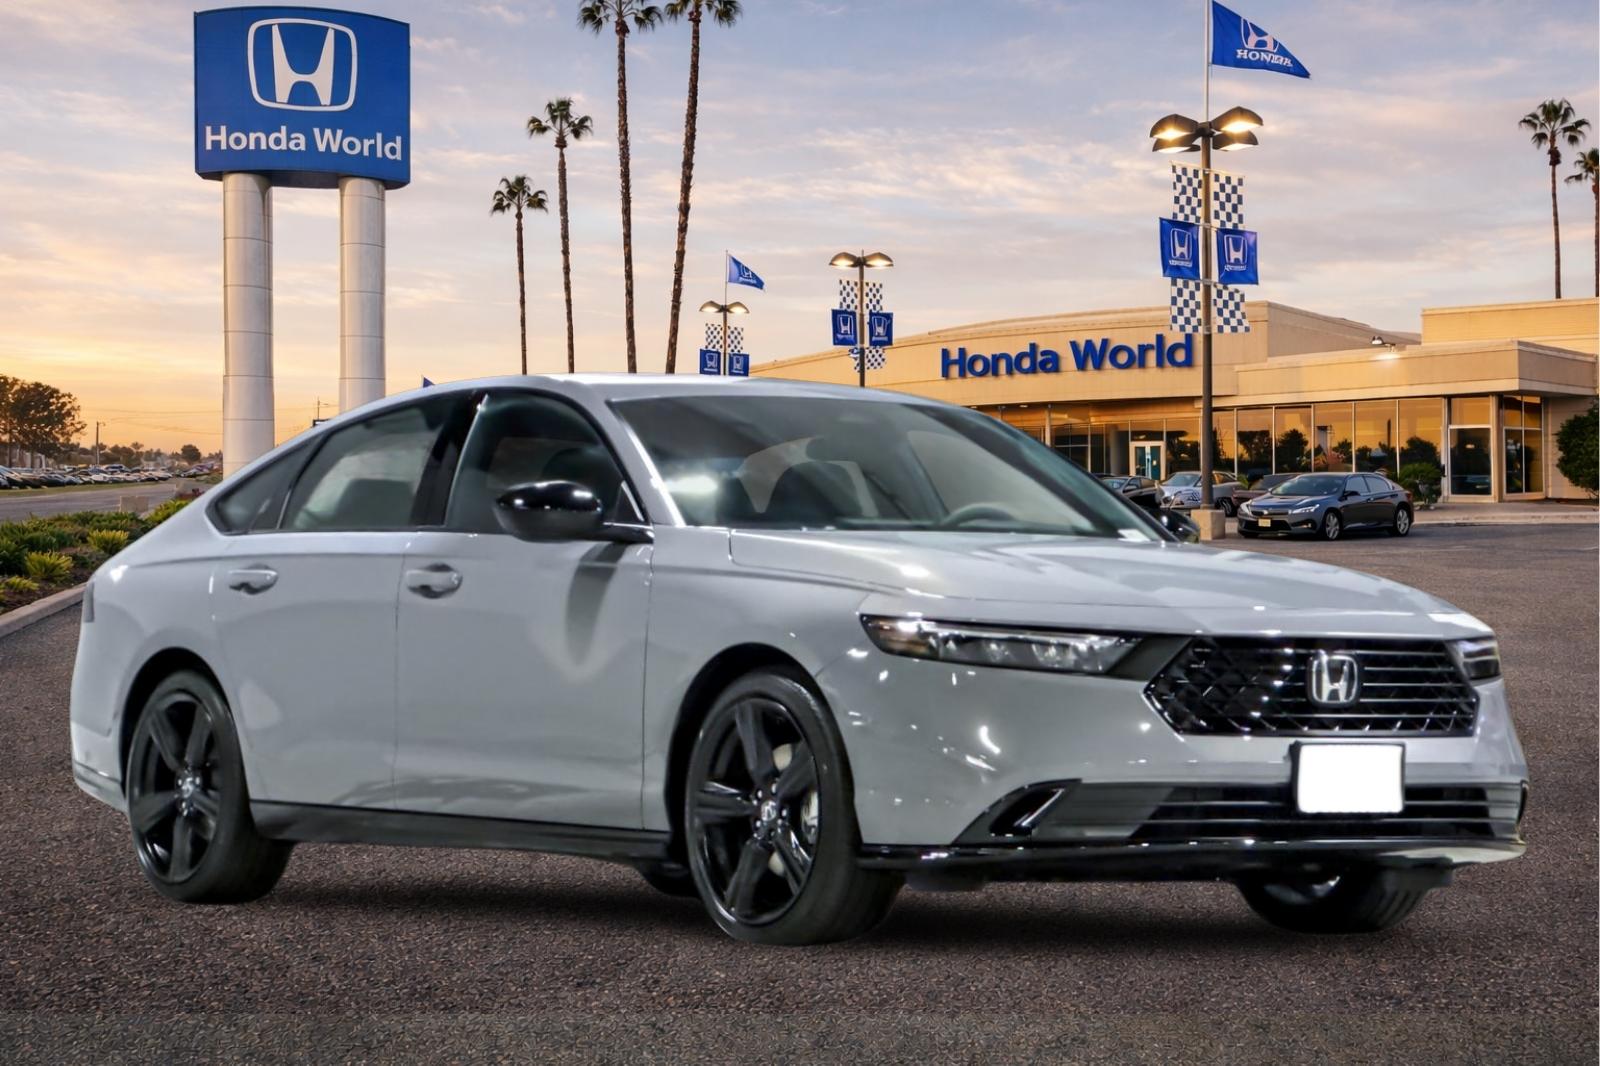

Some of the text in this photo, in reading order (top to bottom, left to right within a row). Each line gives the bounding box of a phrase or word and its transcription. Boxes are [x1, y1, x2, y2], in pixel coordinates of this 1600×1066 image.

[205, 125, 402, 161] Honda World
[940, 332, 1194, 379] Honda World
